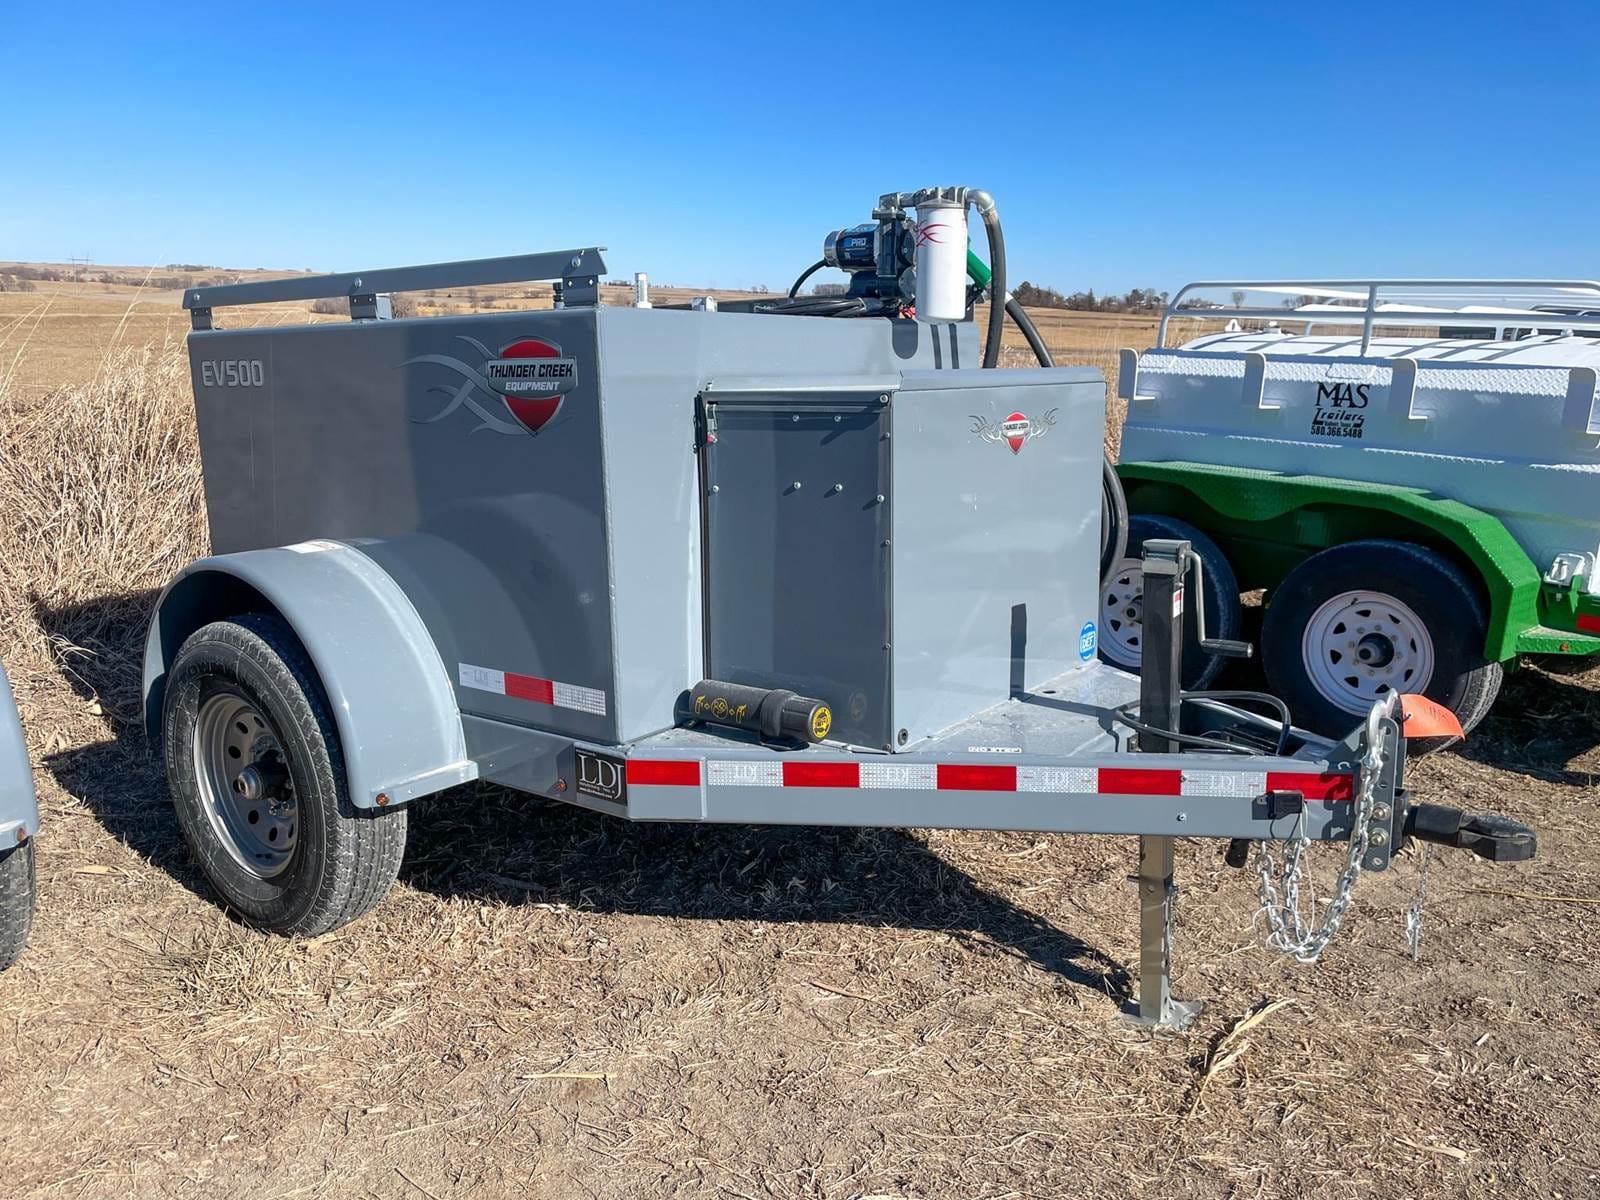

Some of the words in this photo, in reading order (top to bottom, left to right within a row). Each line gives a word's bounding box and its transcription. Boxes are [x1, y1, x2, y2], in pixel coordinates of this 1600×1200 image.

[202, 360, 264, 386] EV500
[490, 364, 536, 378] THUNDER
[538, 363, 573, 378] CREEK
[505, 381, 560, 392] EQUIPMENT
[1314, 381, 1370, 409] MAS
[1310, 426, 1363, 439] 580.366.5488
[577, 754, 625, 799] LDJ
